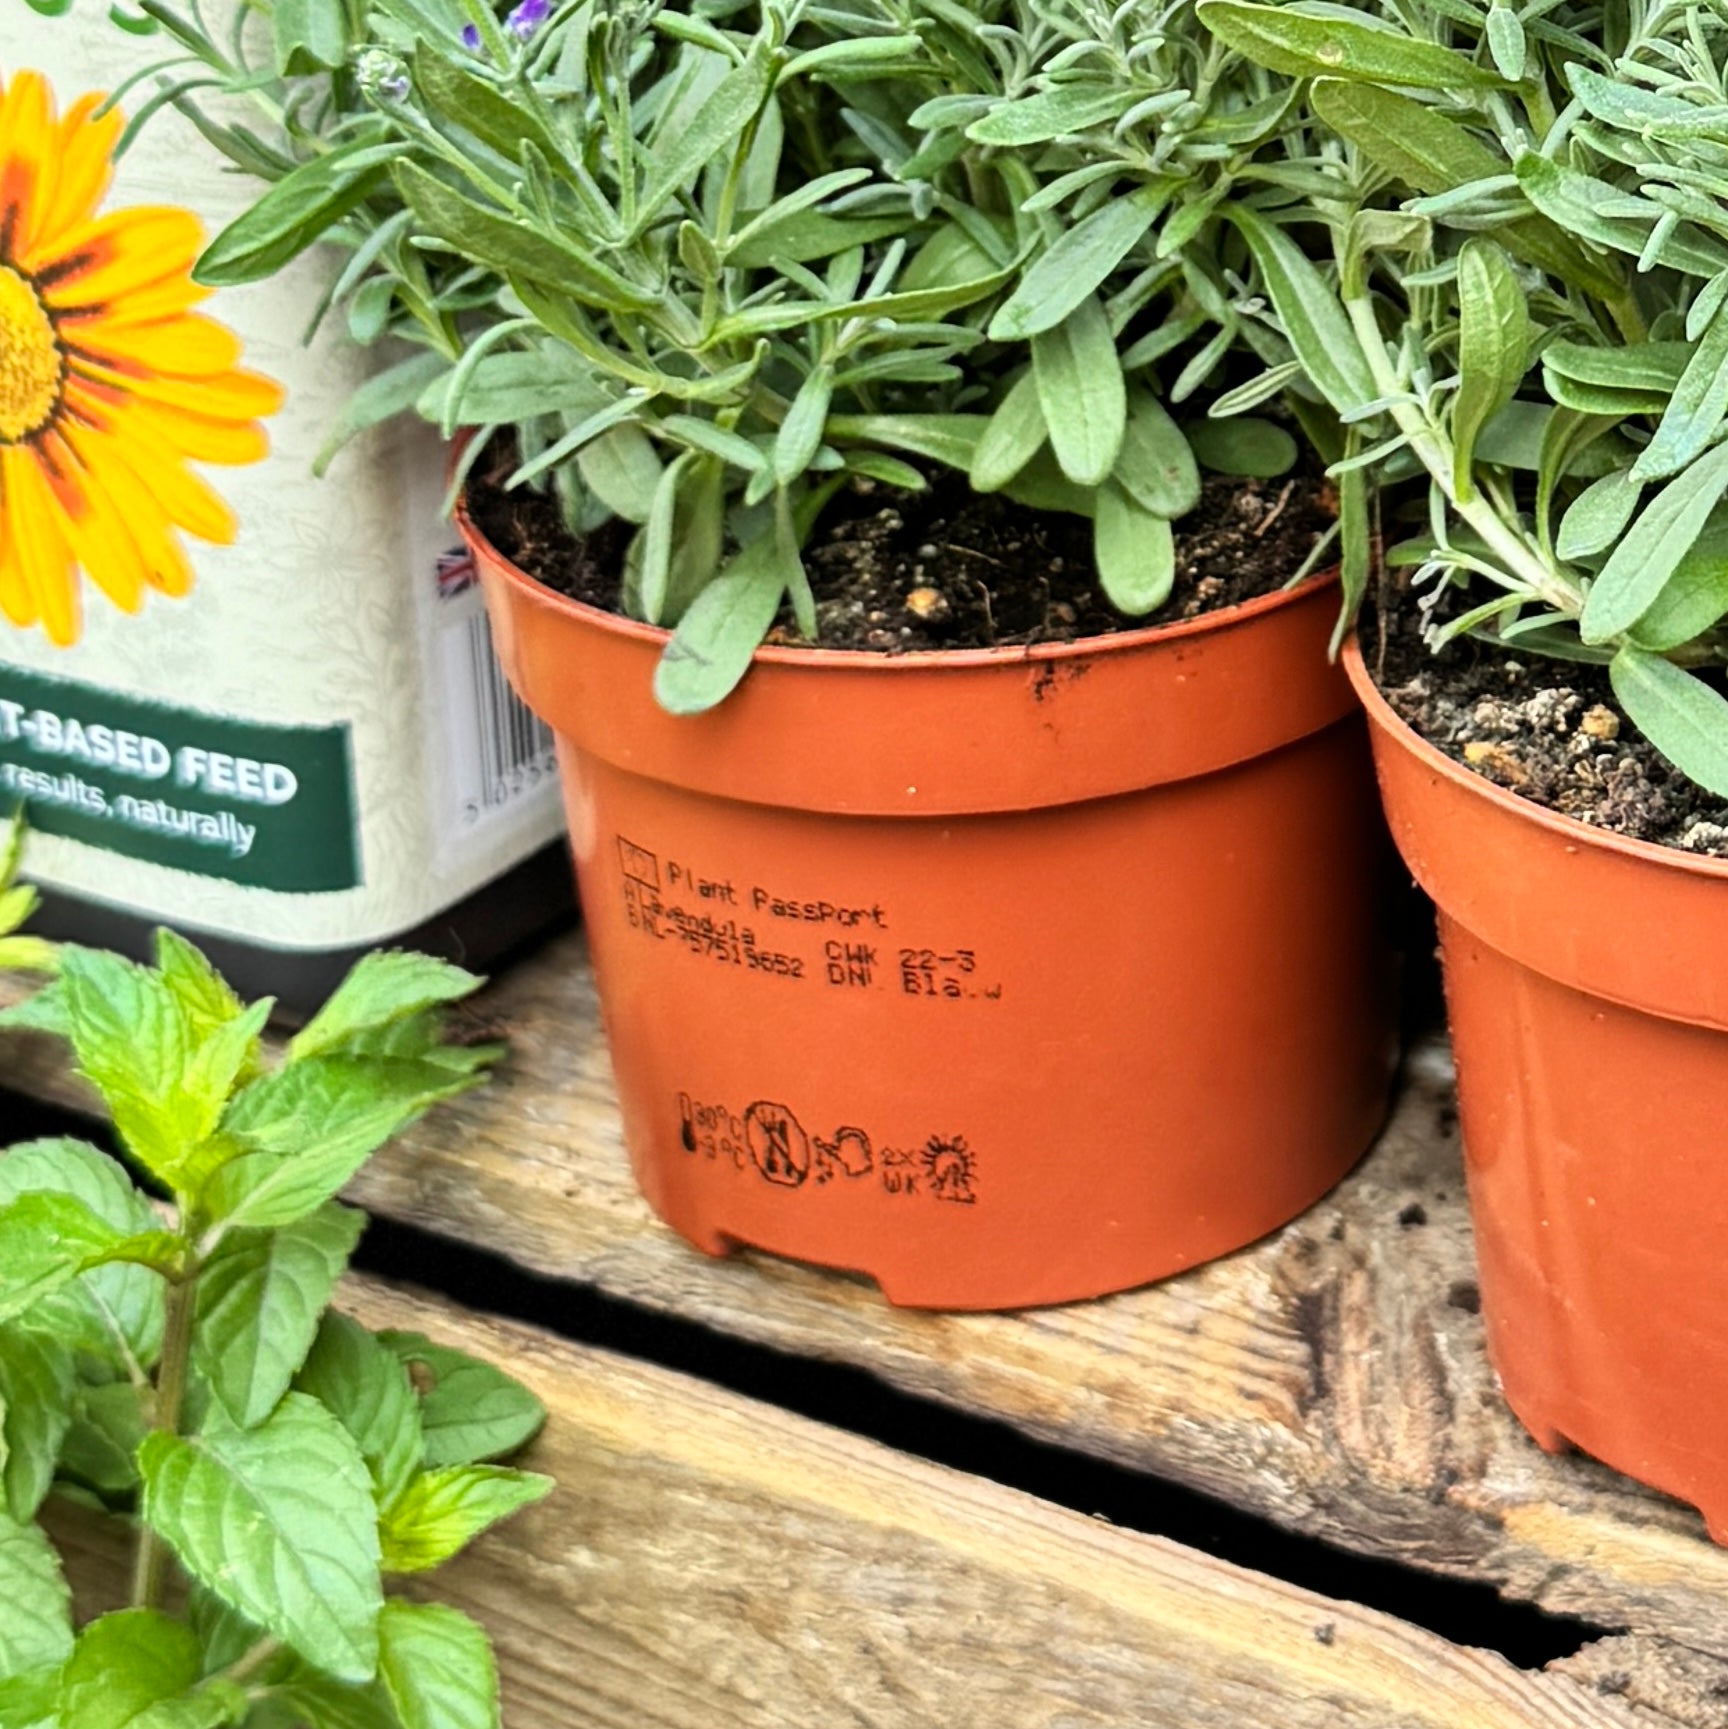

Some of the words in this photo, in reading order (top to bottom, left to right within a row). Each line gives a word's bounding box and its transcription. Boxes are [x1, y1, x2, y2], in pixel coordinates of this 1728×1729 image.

[174, 746, 298, 806] FEED
[110, 794, 257, 858] naturally
[667, 860, 739, 906] Plant
